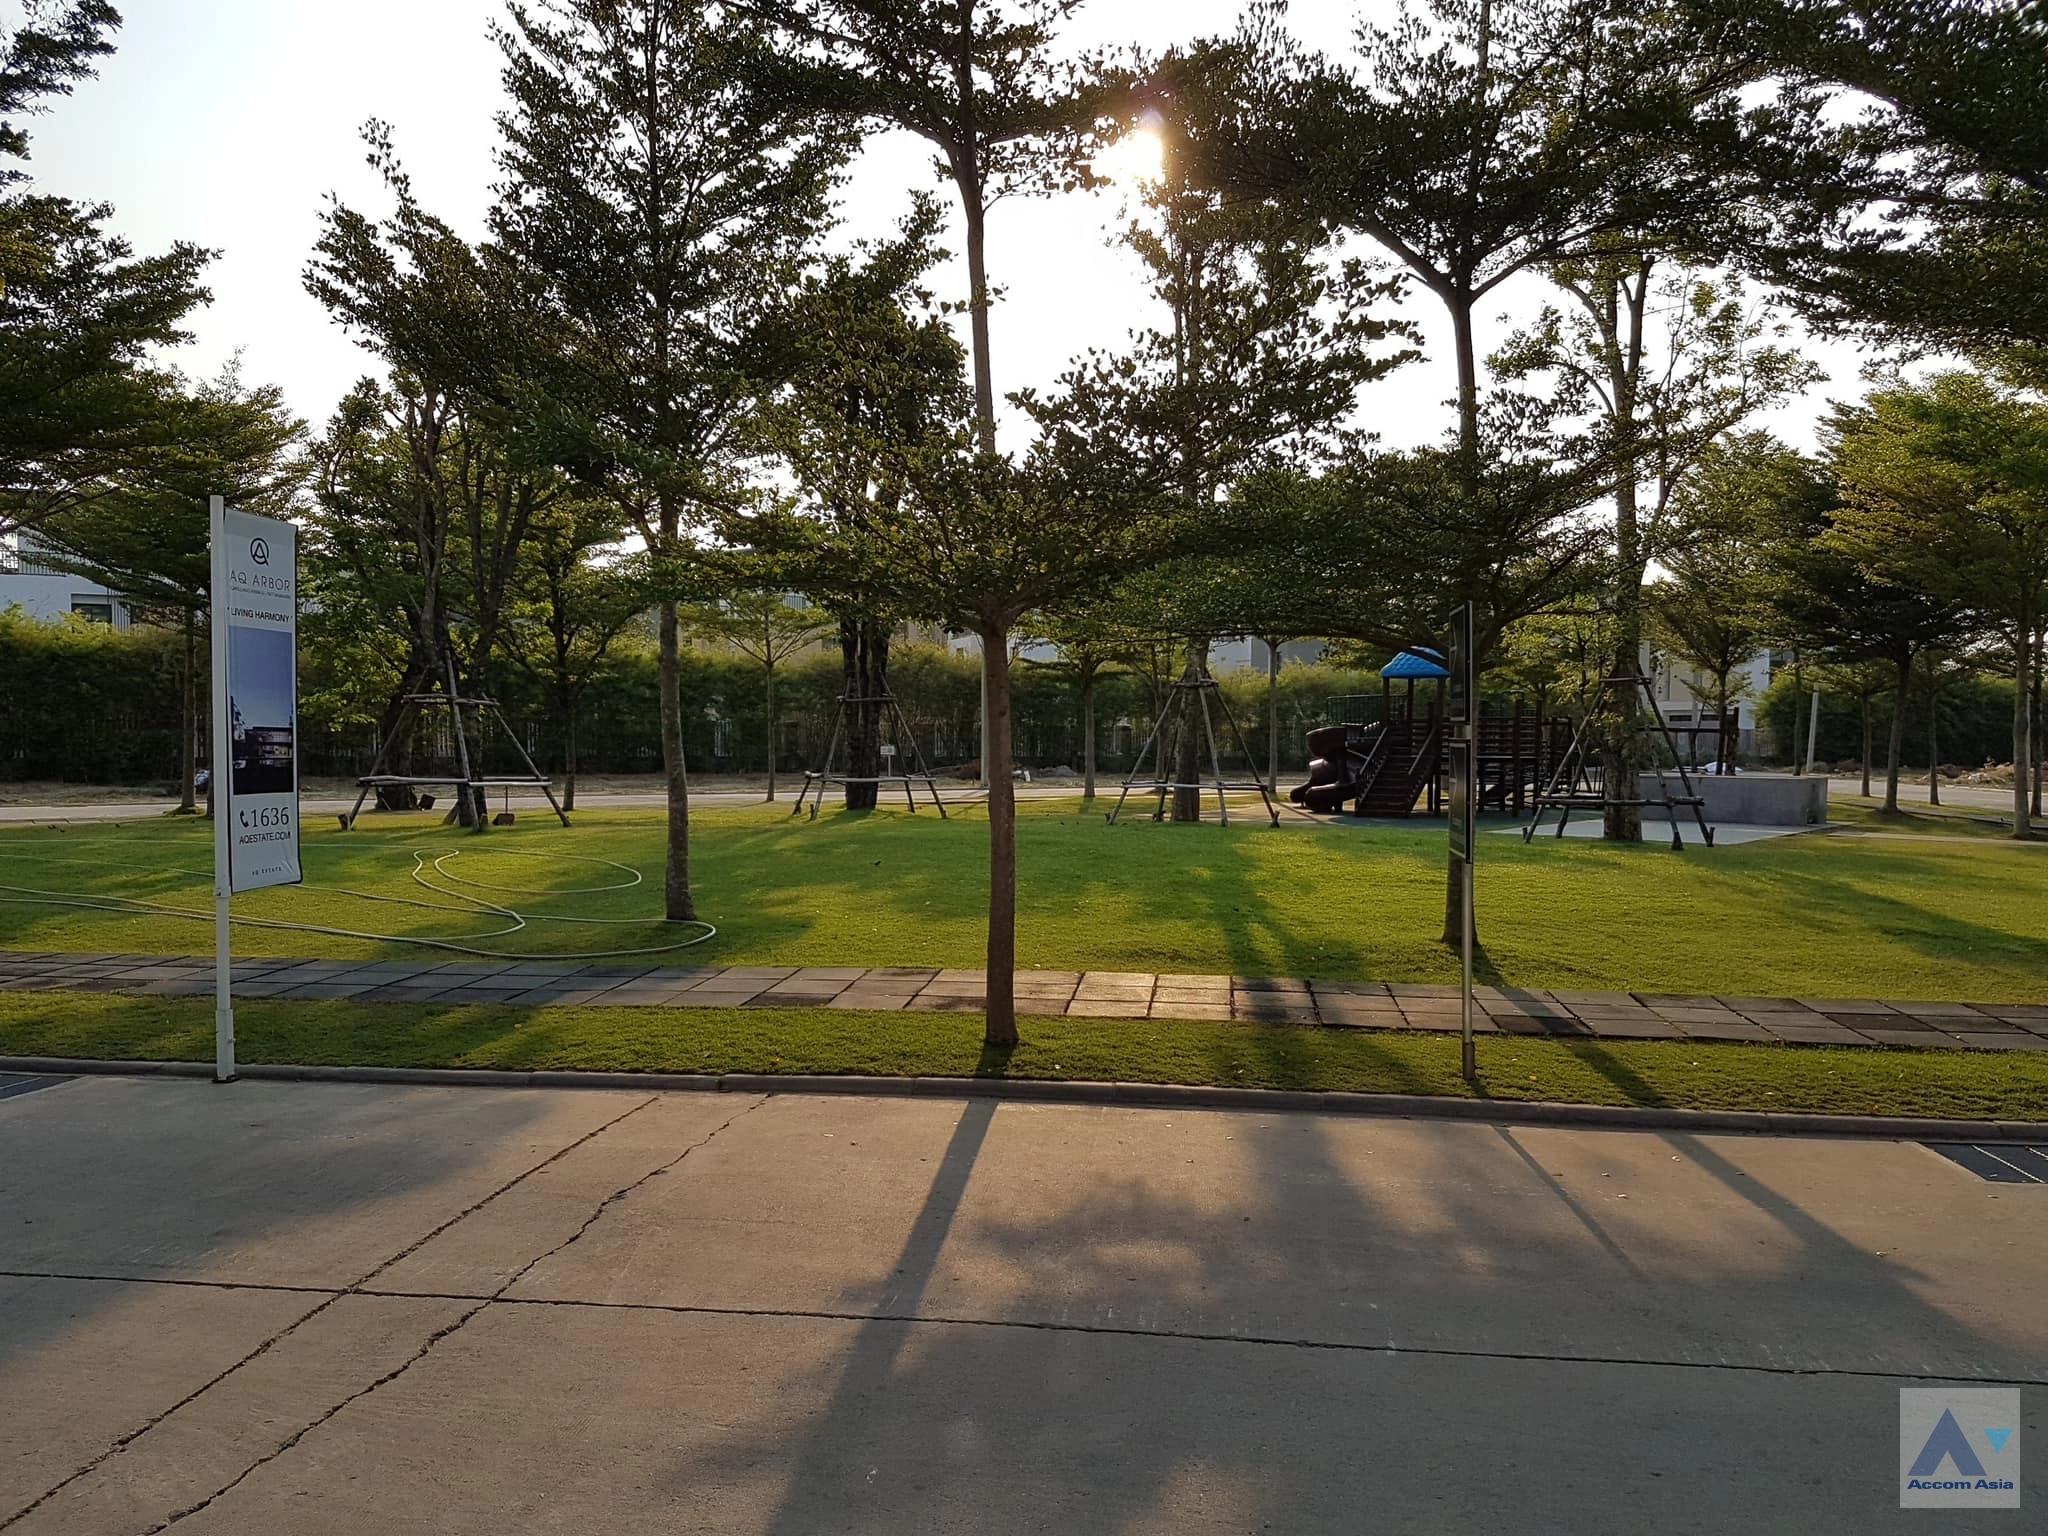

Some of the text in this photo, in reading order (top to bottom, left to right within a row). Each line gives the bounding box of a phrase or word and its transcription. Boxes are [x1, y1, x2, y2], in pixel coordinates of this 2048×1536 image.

[230, 570, 290, 592] AQ ARBOR
[251, 806, 290, 828] 1636
[239, 831, 291, 845] AQESTATE.COM
